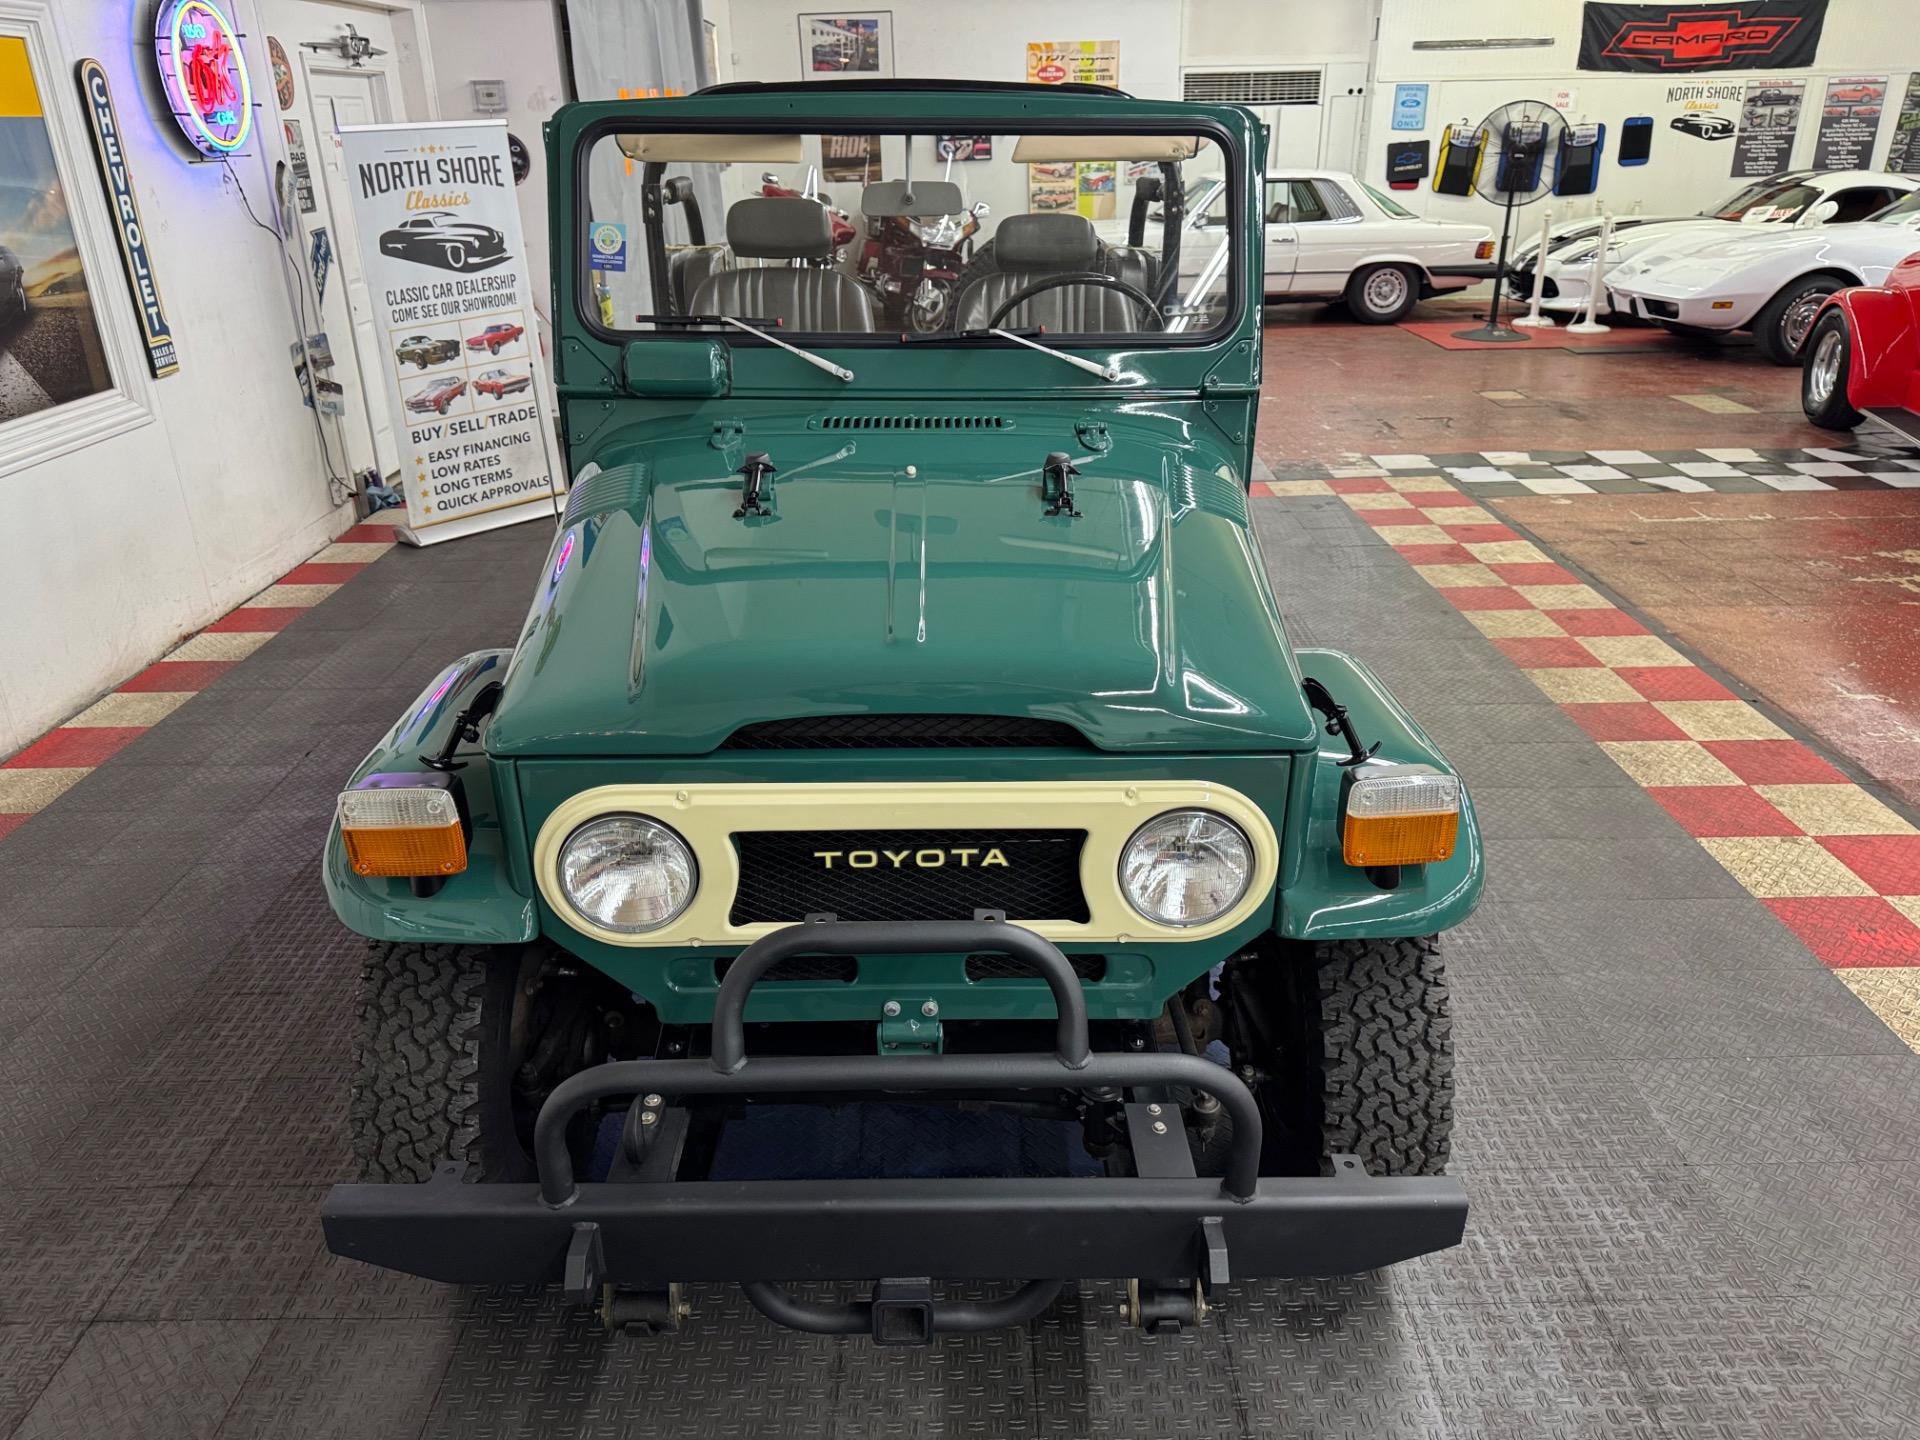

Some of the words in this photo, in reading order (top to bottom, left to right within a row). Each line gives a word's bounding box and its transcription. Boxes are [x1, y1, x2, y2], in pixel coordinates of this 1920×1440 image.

[1632, 30, 1768, 45] CAMARO
[1666, 87, 1704, 104] NORTH
[1706, 85, 1744, 102] SHORE
[1684, 100, 1720, 110] Classics
[830, 136, 870, 158] RIDE
[358, 160, 432, 199] NORTH
[435, 154, 504, 188] SHORE
[1394, 164, 1423, 172] CHEVROLET
[91, 76, 161, 331] CHEVROLET
[404, 190, 471, 210] Classics
[386, 285, 430, 306] CLASSIC
[432, 281, 454, 299] CAR
[456, 274, 517, 296] DEALERSHIP
[392, 306, 419, 323] COME
[421, 303, 439, 319] SEE
[441, 299, 461, 316] OUR
[462, 292, 517, 312] SHOWROOM!
[152, 347, 168, 358] SALES
[154, 354, 177, 368] SERVICE
[428, 446, 460, 463] EASY
[463, 431, 531, 457] FINANCING
[431, 464, 460, 480] LOW
[464, 454, 501, 469] RATES
[434, 478, 470, 496] LONG
[472, 468, 513, 487] TERMS
[437, 493, 478, 511] QUICK
[480, 475, 550, 502] APPROVALS
[814, 848, 1010, 868] TOYOTA
